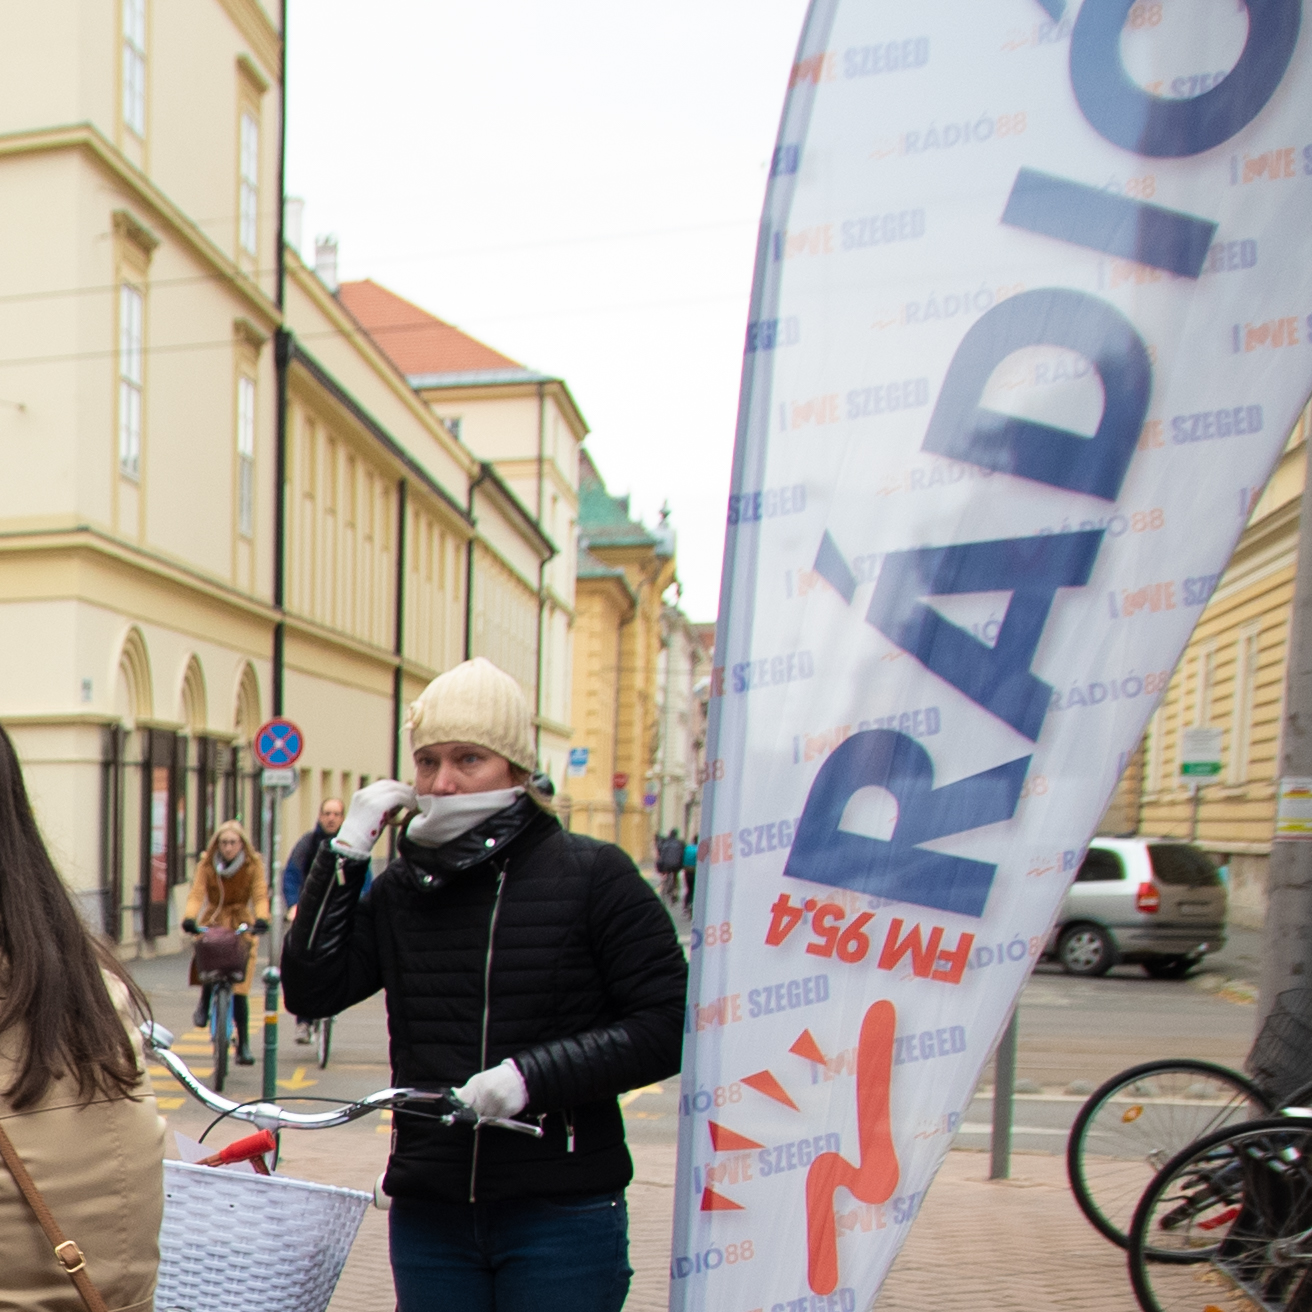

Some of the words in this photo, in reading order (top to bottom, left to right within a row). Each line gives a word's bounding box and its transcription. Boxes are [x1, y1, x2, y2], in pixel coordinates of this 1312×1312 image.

[842, 34, 930, 79] SZEGED
[905, 106, 1026, 155] RÁDIÓ88
[840, 206, 926, 250] SZEGED
[846, 377, 929, 421] SZEGED
[1170, 404, 1264, 446] SZEGED
[732, 650, 815, 694] SZEGED
[764, 892, 876, 965] 95.4
[877, 917, 976, 985] FM
[747, 973, 830, 1019] SZEGED
[893, 1025, 967, 1067] ZEGED
